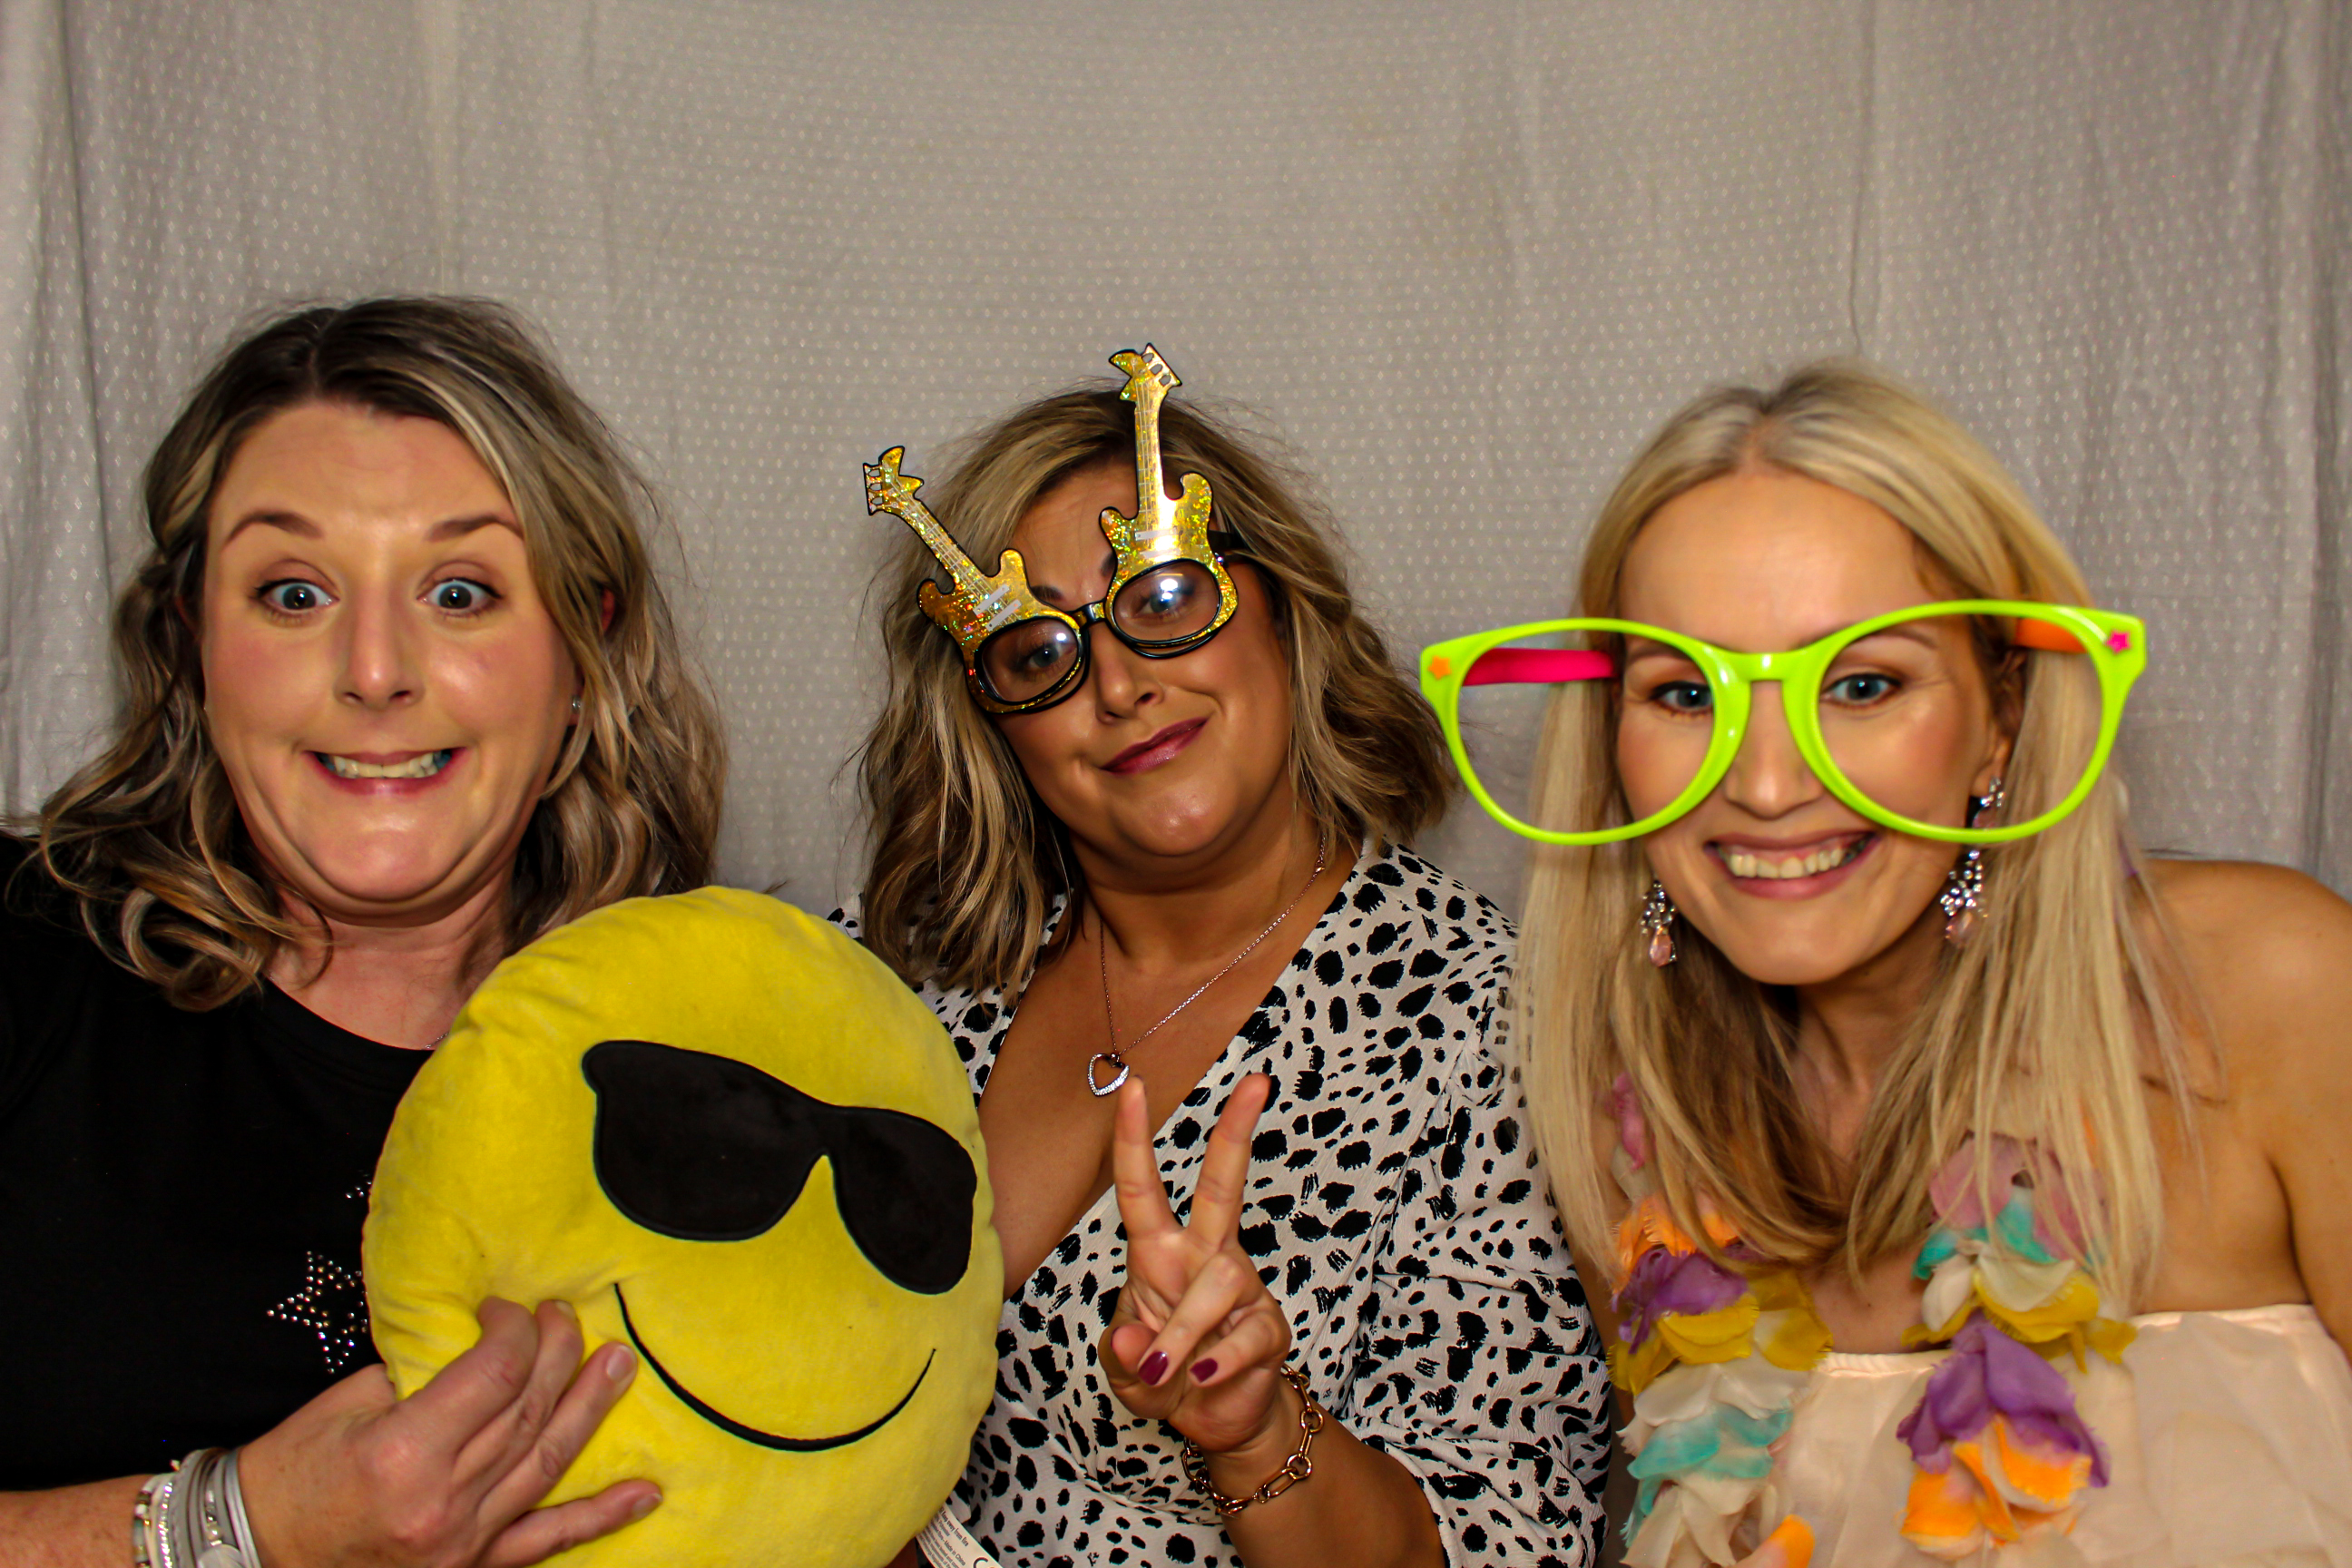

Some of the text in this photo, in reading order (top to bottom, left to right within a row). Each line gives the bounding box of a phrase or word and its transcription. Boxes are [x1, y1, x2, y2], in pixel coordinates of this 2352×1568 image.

[954, 1527, 963, 1540] from
[961, 1536, 969, 1546] fire
[955, 1553, 965, 1566] China
